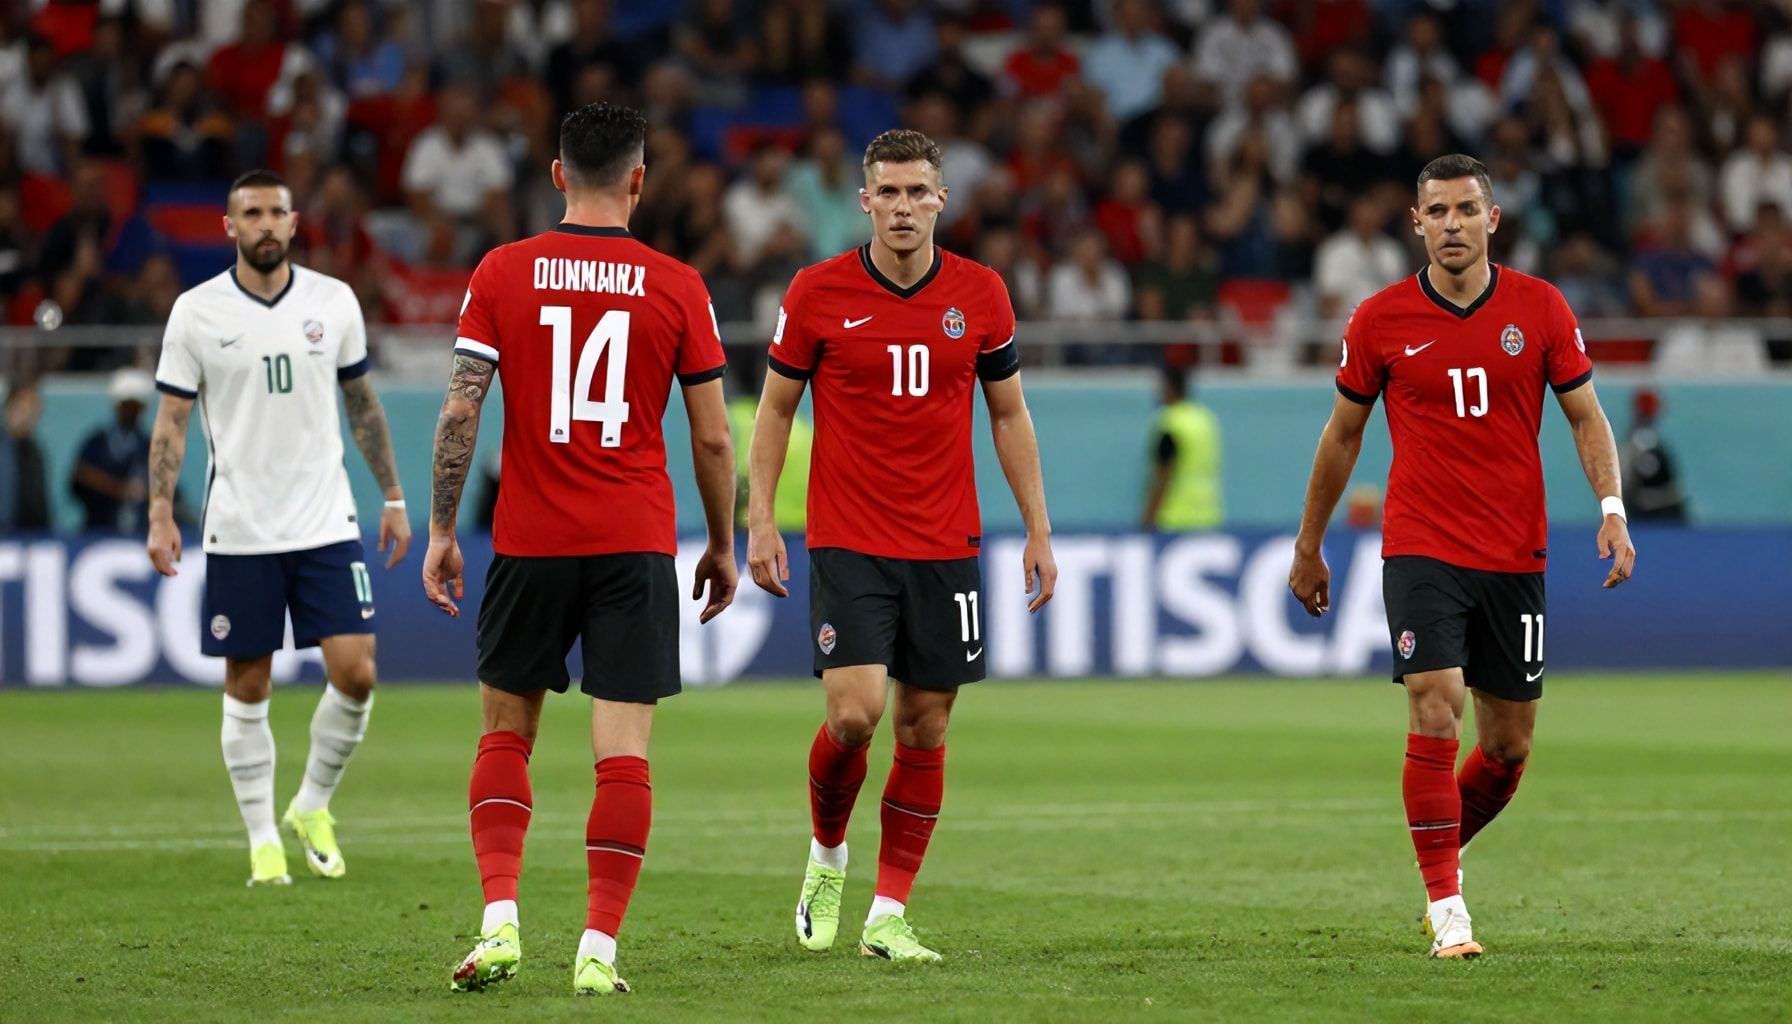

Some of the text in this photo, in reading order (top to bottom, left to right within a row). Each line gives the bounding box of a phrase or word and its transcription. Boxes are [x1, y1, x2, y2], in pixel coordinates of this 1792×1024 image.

[262, 353, 293, 394] 10
[539, 305, 631, 448] 14
[888, 345, 930, 397] 10
[954, 590, 980, 642] 11
[1520, 613, 1544, 662] 11
